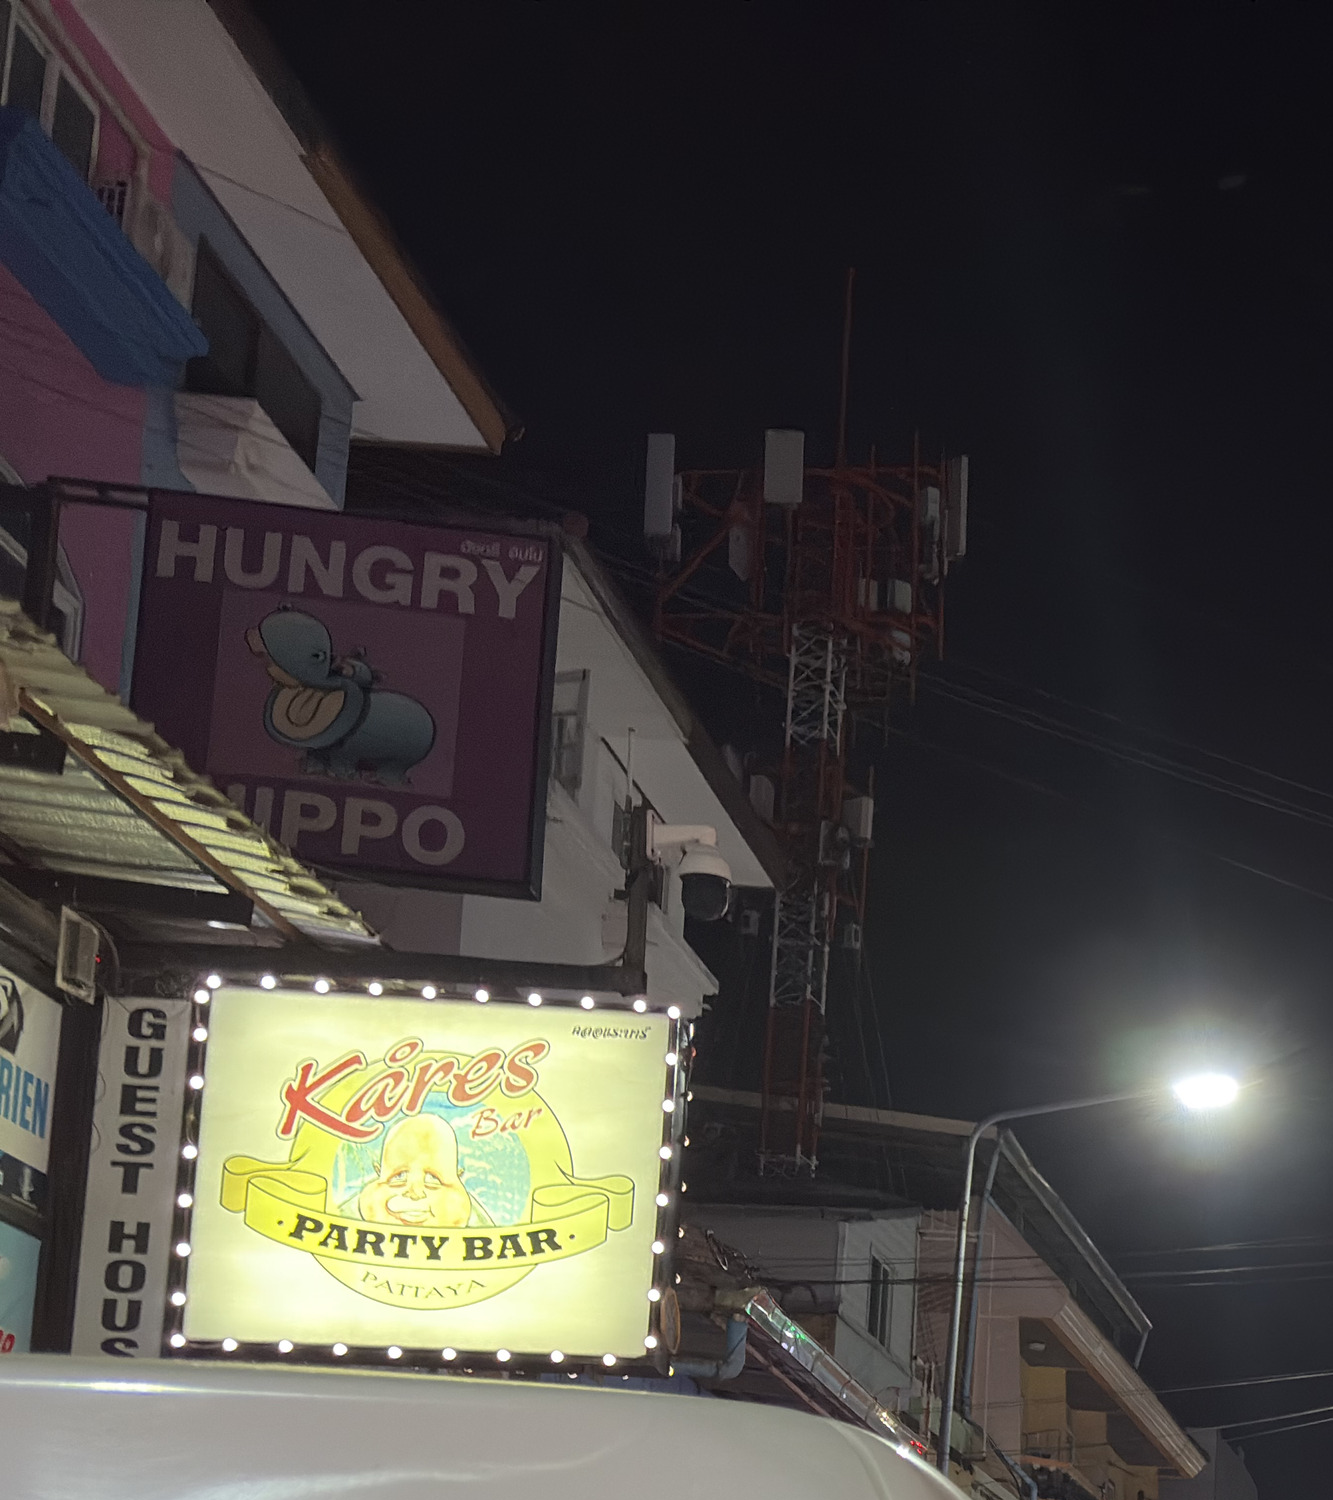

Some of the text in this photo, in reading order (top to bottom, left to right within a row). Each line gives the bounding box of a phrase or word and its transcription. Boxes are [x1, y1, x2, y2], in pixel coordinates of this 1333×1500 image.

[157, 519, 541, 620] HUNGRY
[110, 1007, 168, 1196] GUEST
[471, 1100, 544, 1141] Bar
[287, 1212, 564, 1264] PARTY BAR
[358, 1271, 488, 1300] PATTAYA
